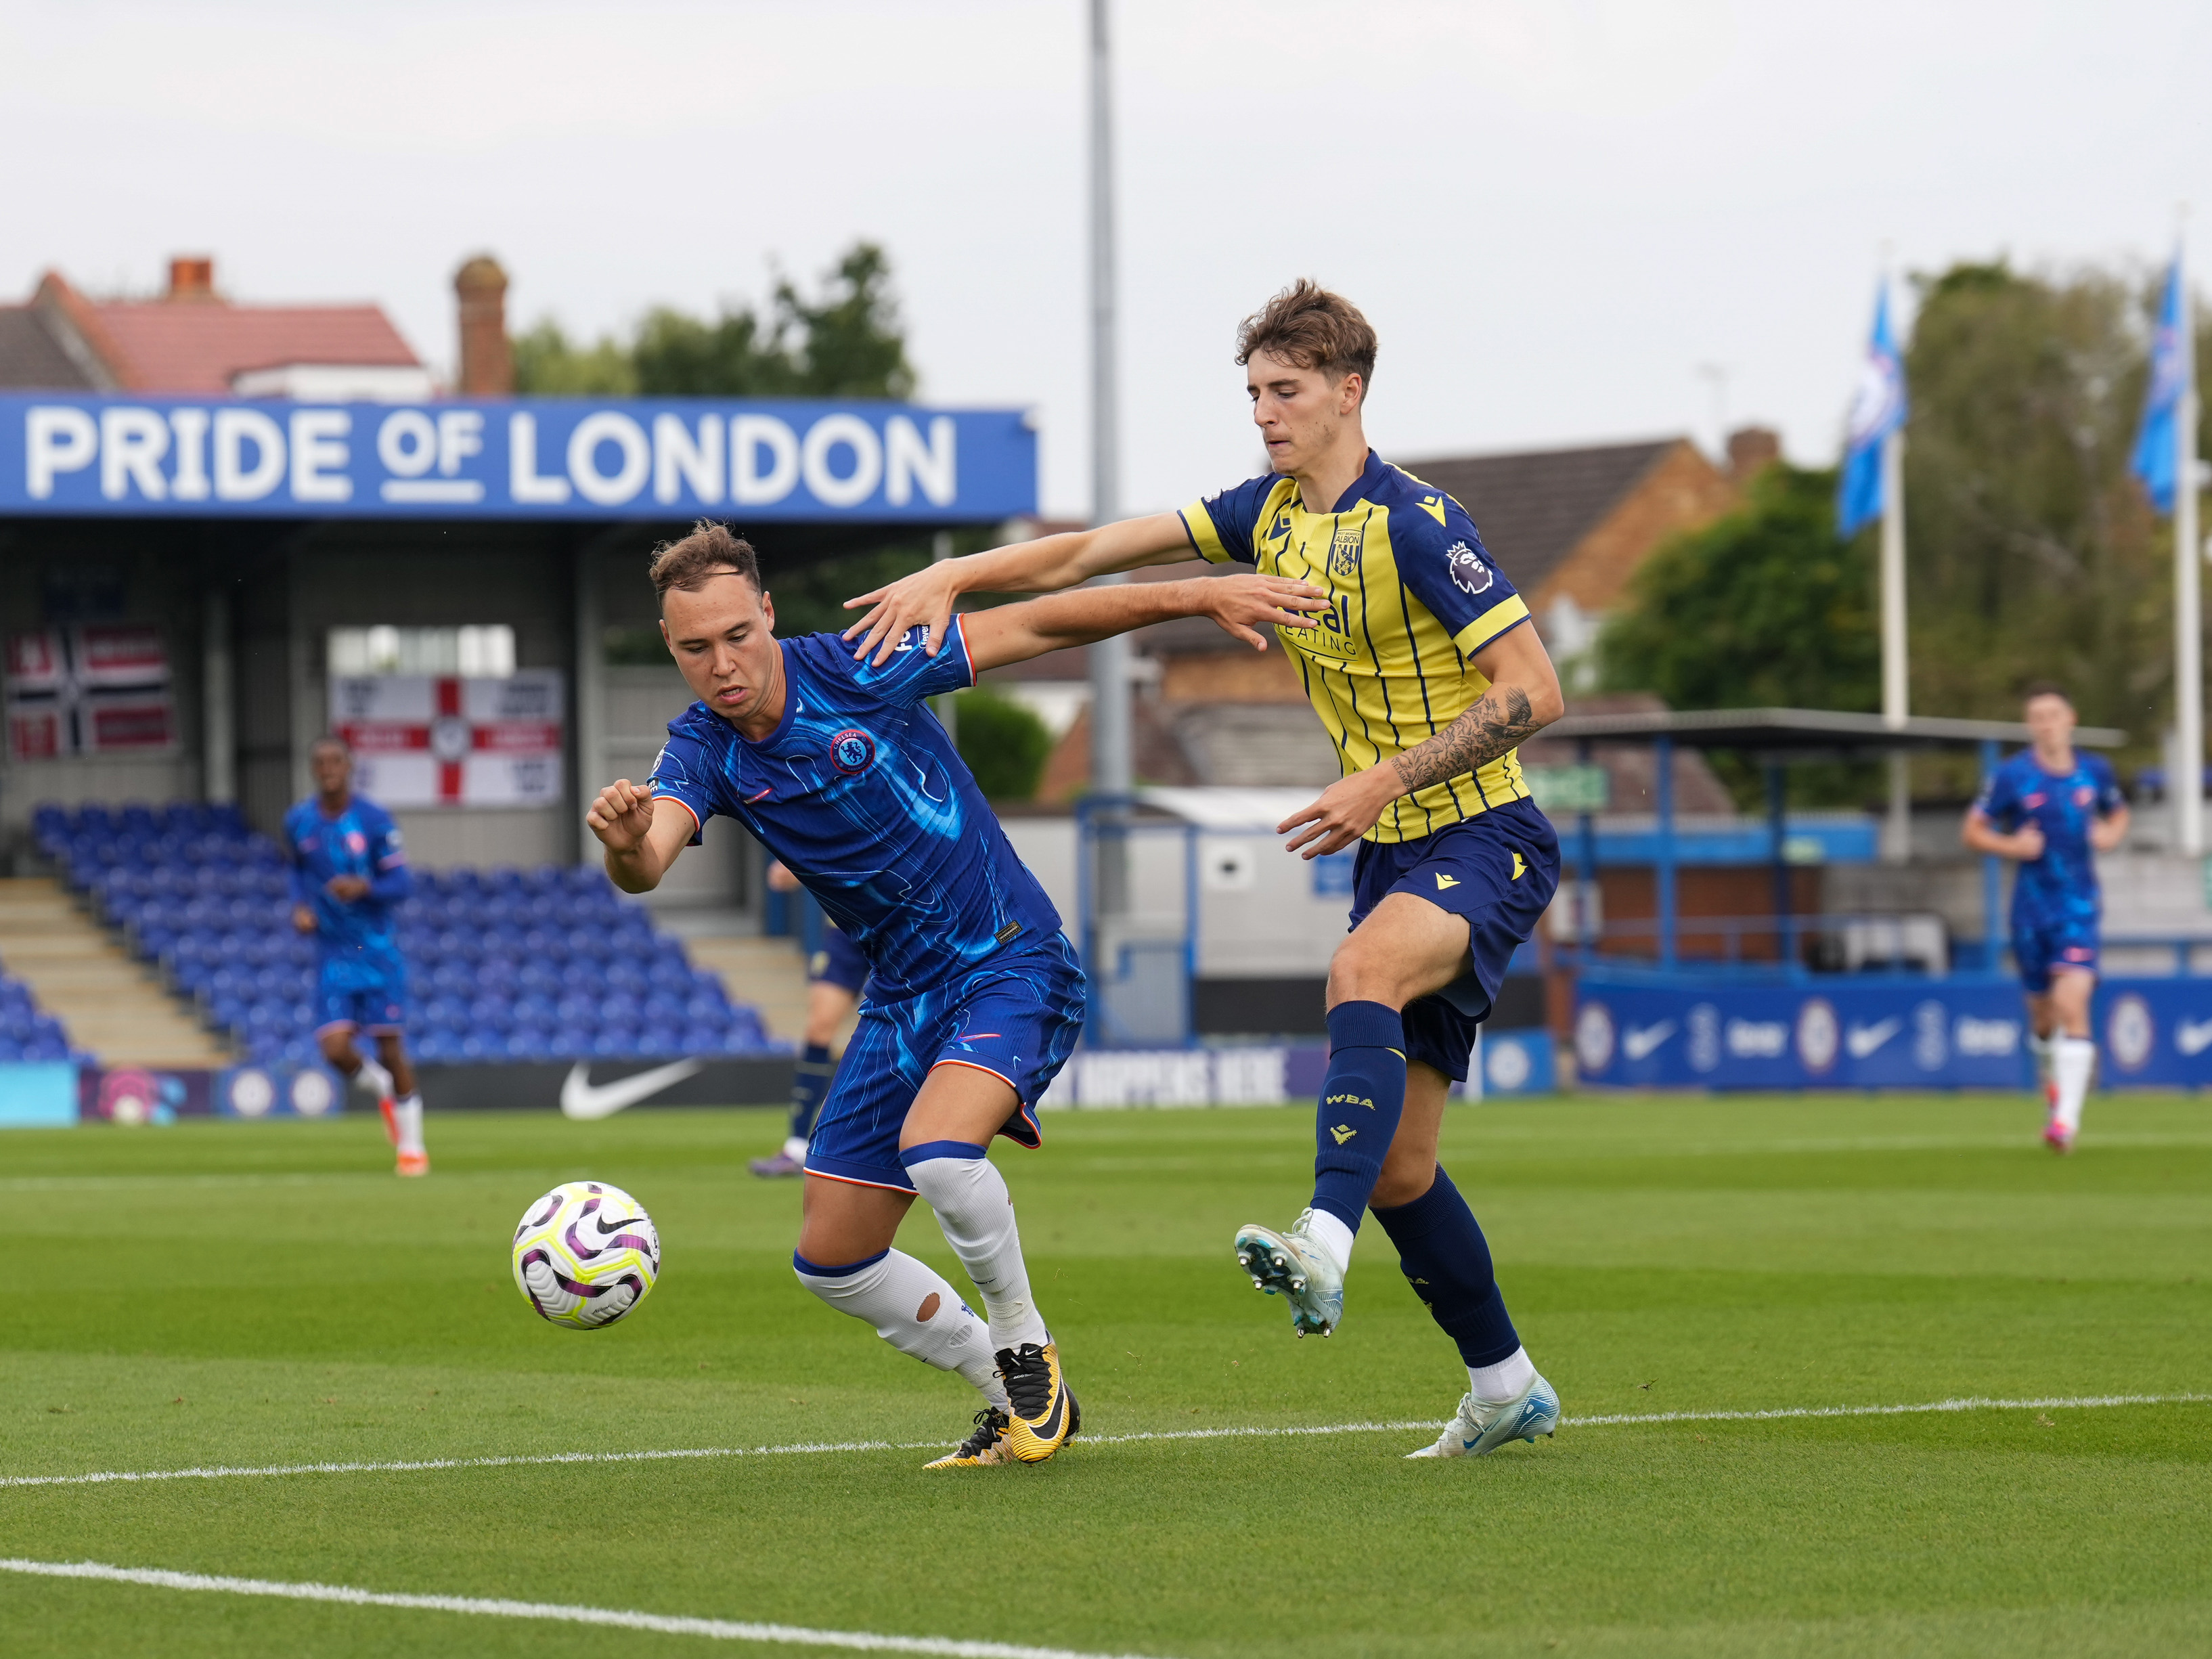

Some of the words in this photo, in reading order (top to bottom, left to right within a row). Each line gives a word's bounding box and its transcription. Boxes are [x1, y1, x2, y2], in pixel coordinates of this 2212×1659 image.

[26, 406, 353, 502] PRIDE
[378, 408, 485, 477] OF
[509, 410, 957, 507] LONDON
[1335, 535, 1360, 544] ALBION
[833, 732, 857, 749] CHELSEA
[1326, 1094, 1375, 1110] WBA
[1406, 1276, 1430, 1285] BA
